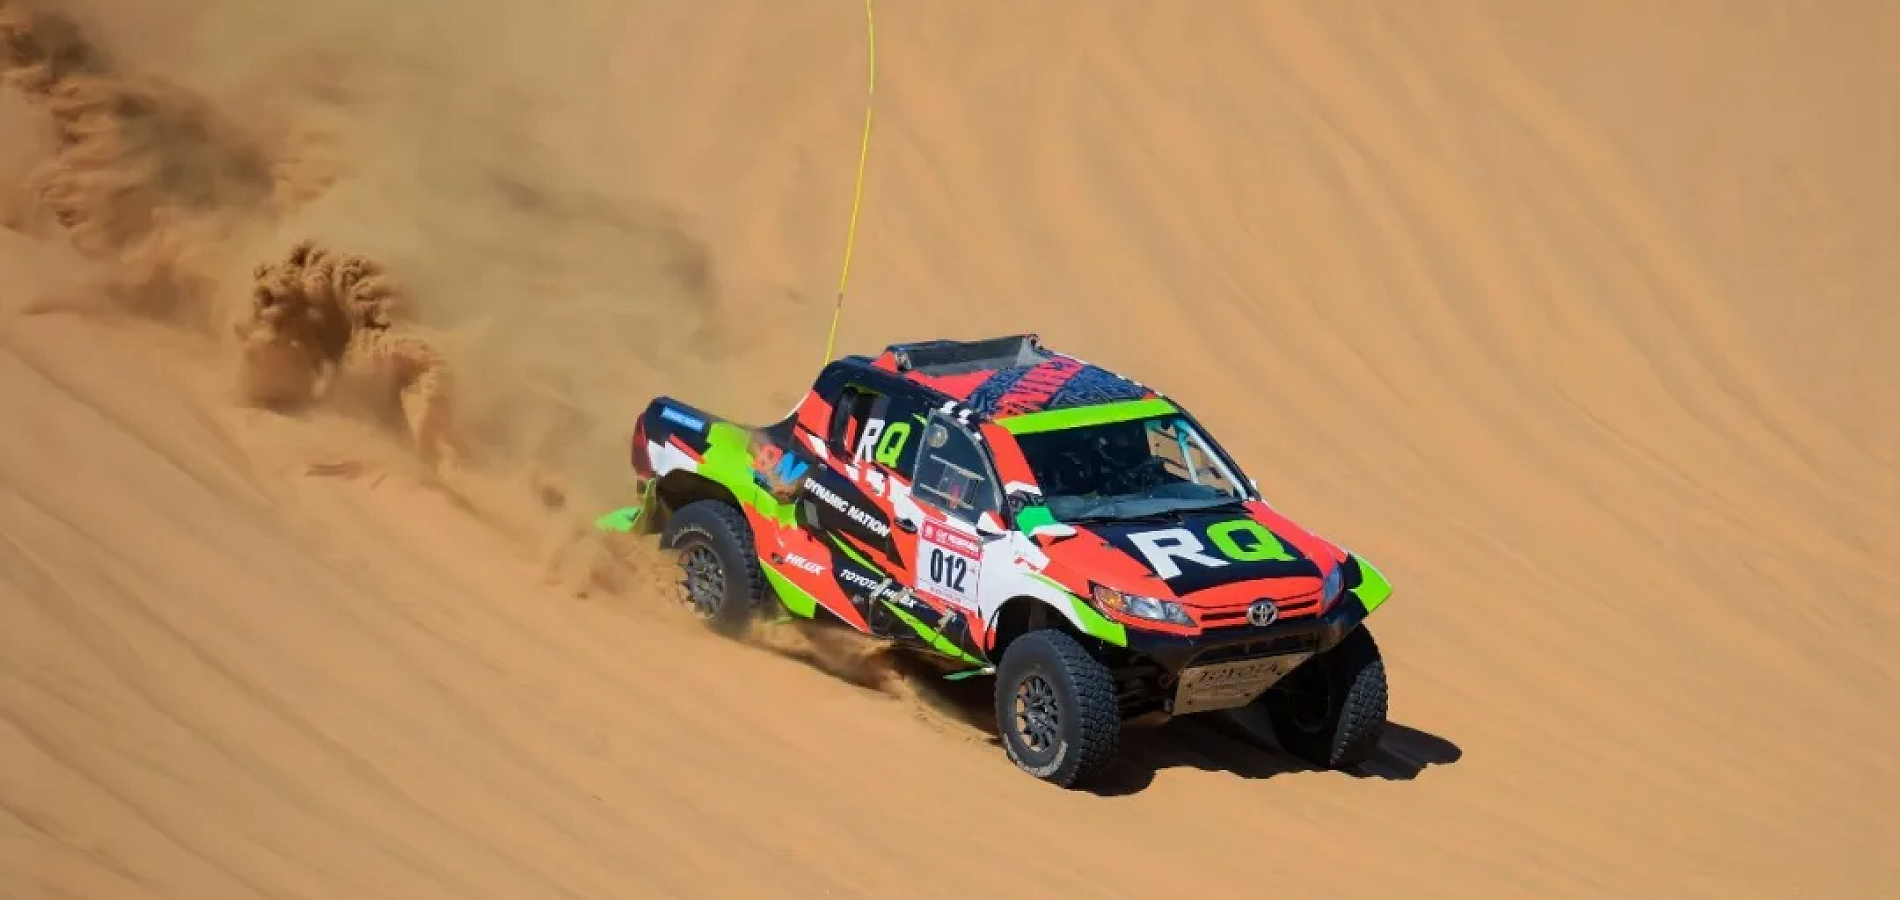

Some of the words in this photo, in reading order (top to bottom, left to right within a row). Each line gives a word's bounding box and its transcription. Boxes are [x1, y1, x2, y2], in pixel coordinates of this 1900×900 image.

[853, 417, 911, 468] RQ
[803, 476, 850, 513] DYNAMIC
[846, 504, 891, 537] NATION
[785, 551, 826, 576] HILUX
[930, 547, 967, 594] 012
[1126, 518, 1298, 580] RQ
